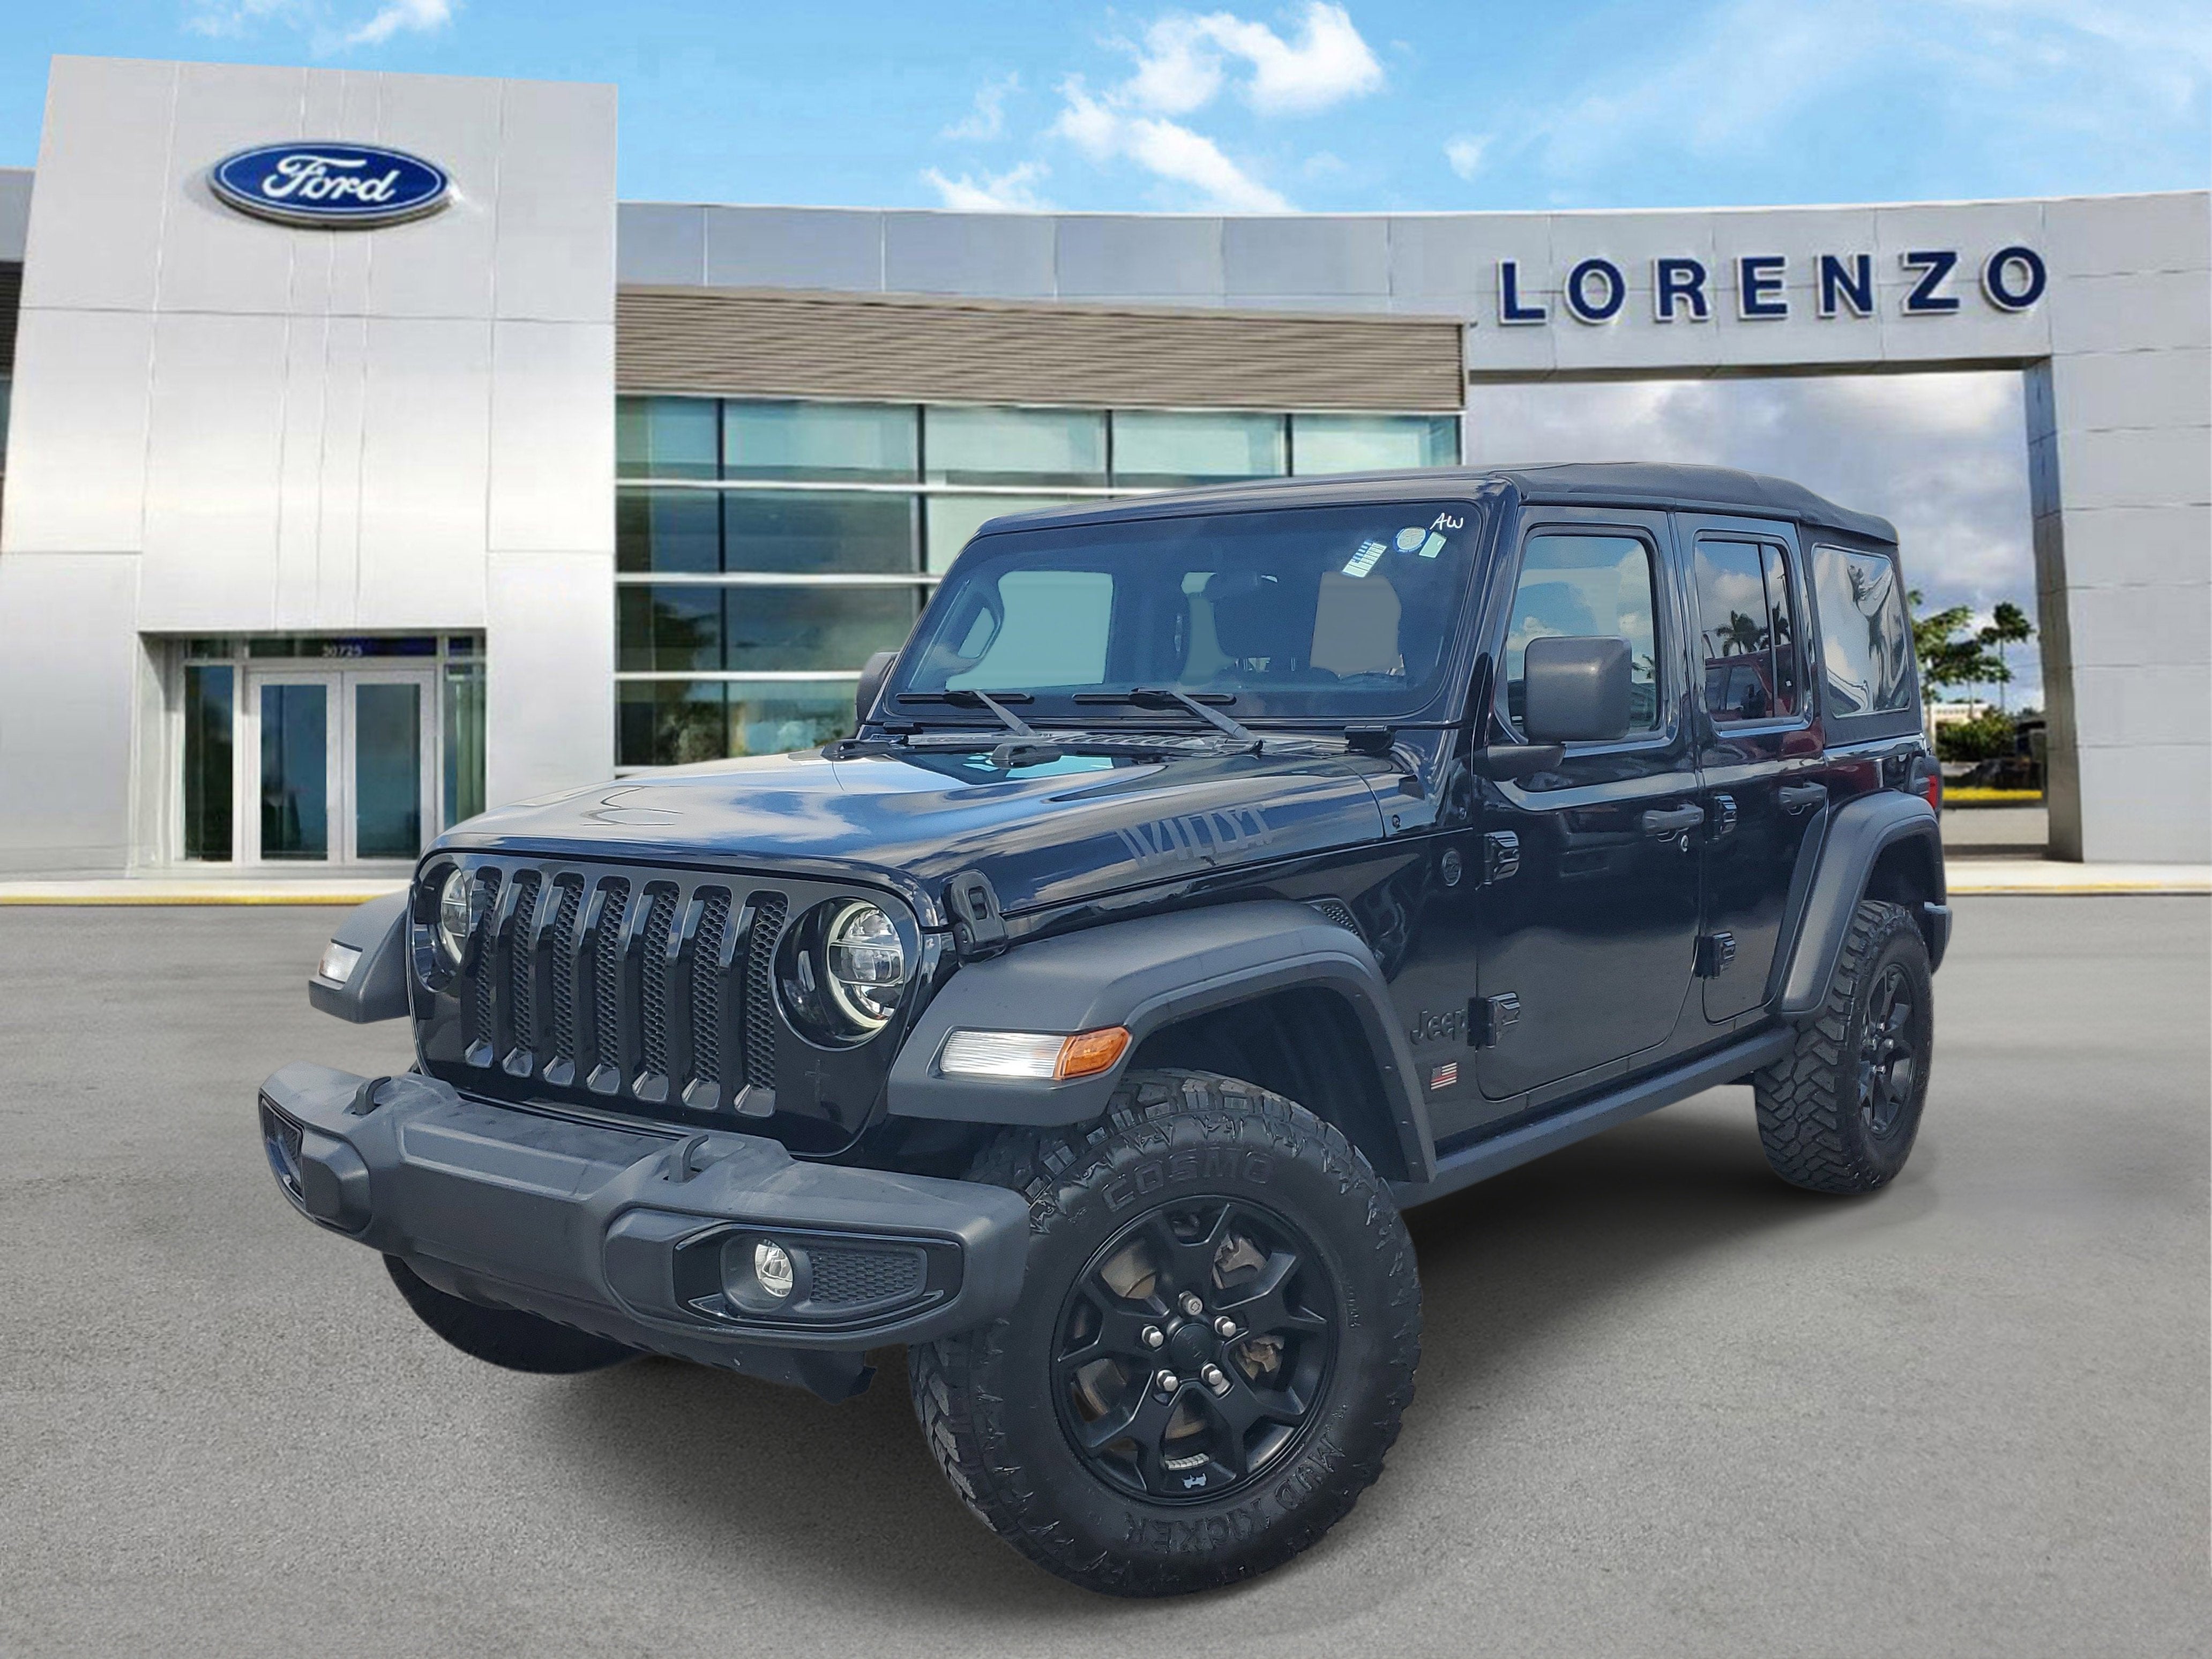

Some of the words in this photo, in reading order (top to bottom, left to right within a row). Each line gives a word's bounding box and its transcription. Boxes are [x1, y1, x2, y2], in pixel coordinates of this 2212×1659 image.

[261, 154, 401, 201] Ford
[1500, 246, 2046, 325] LORENZO
[1410, 1007, 1467, 1045] Jeep
[1101, 1146, 1274, 1212] COSMO
